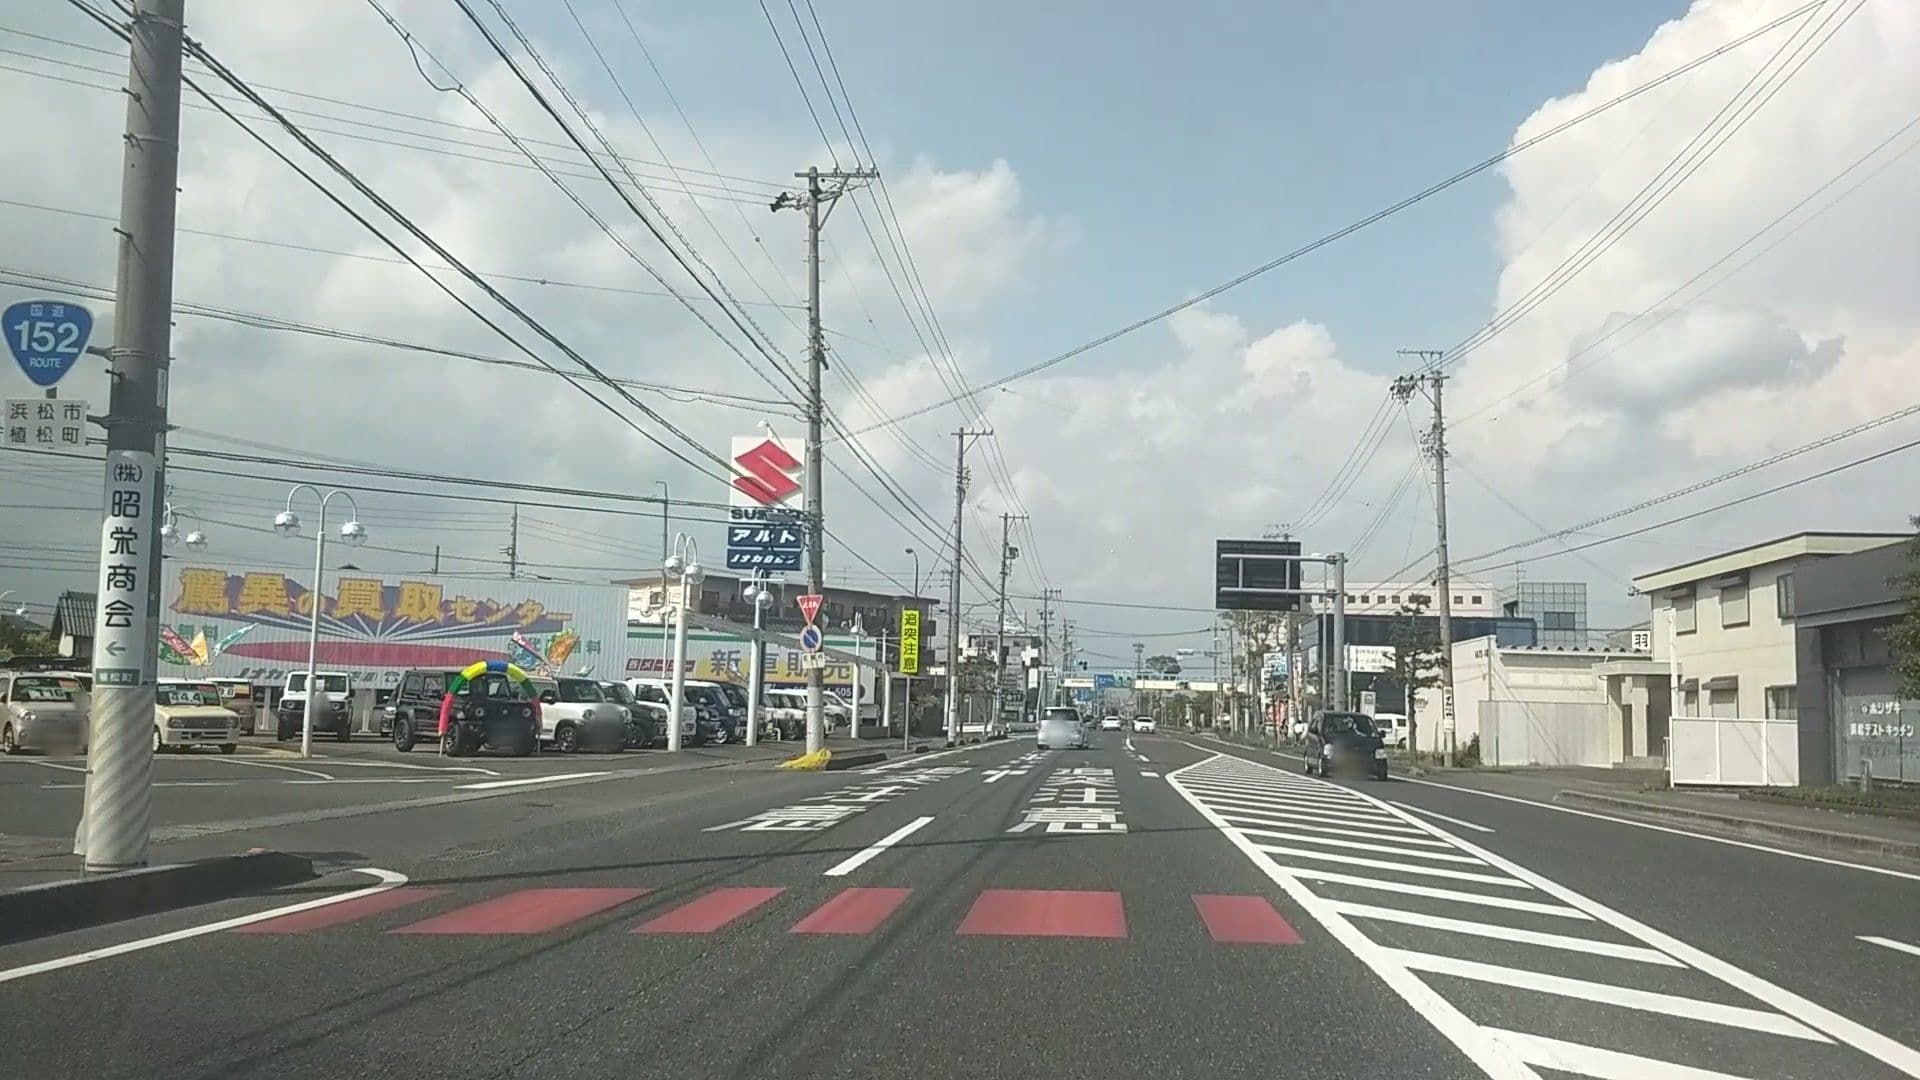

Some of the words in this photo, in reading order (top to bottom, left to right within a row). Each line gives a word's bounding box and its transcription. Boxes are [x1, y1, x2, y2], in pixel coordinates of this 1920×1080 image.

[30, 304, 65, 317] 国道
[14, 320, 79, 353] 152
[29, 358, 62, 368] ROUTE
[10, 403, 81, 420] 浜松市
[10, 427, 80, 444] 植松町
[730, 508, 802, 521] SUZ
[733, 529, 796, 543] アルト
[178, 567, 573, 627] 驚異の買取センター
[903, 613, 918, 671] 追突注意
[1634, 633, 1648, 648] 羽
[1005, 767, 1128, 833] 追突注意
